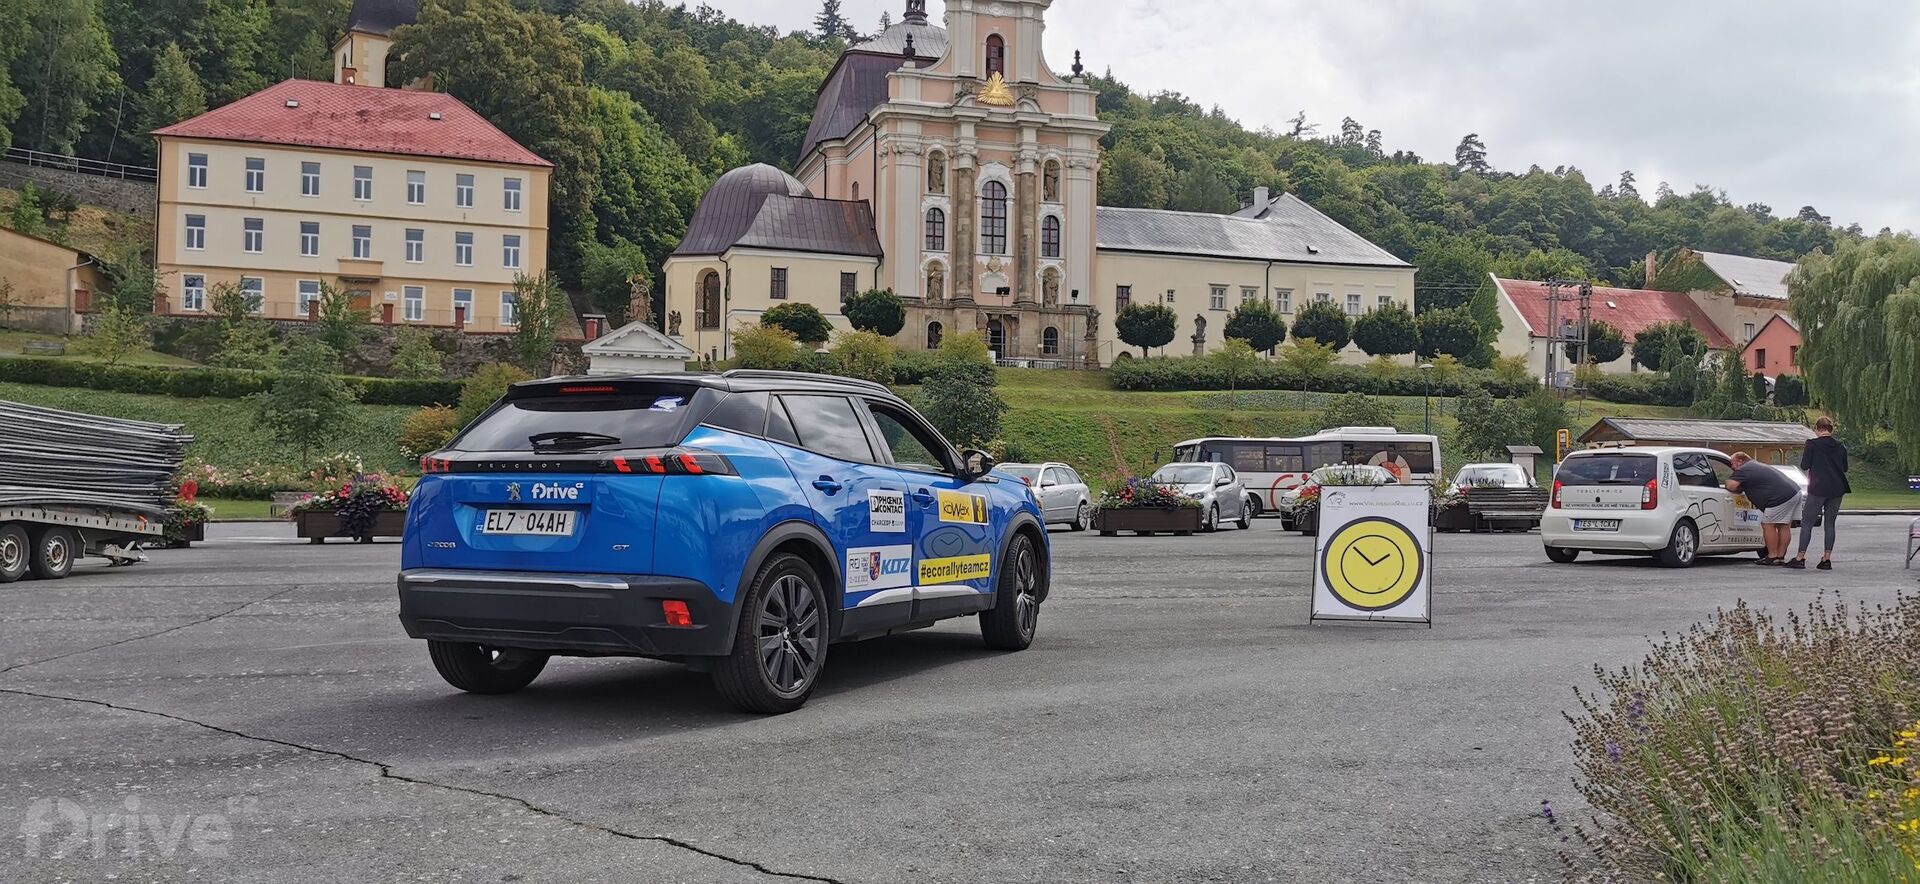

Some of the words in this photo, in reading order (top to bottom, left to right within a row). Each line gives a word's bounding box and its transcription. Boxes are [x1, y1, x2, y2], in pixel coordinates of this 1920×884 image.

[486, 512, 516, 531] EL7
[526, 512, 567, 533] 04AH
[921, 561, 989, 579] #ecorallyteamcz
